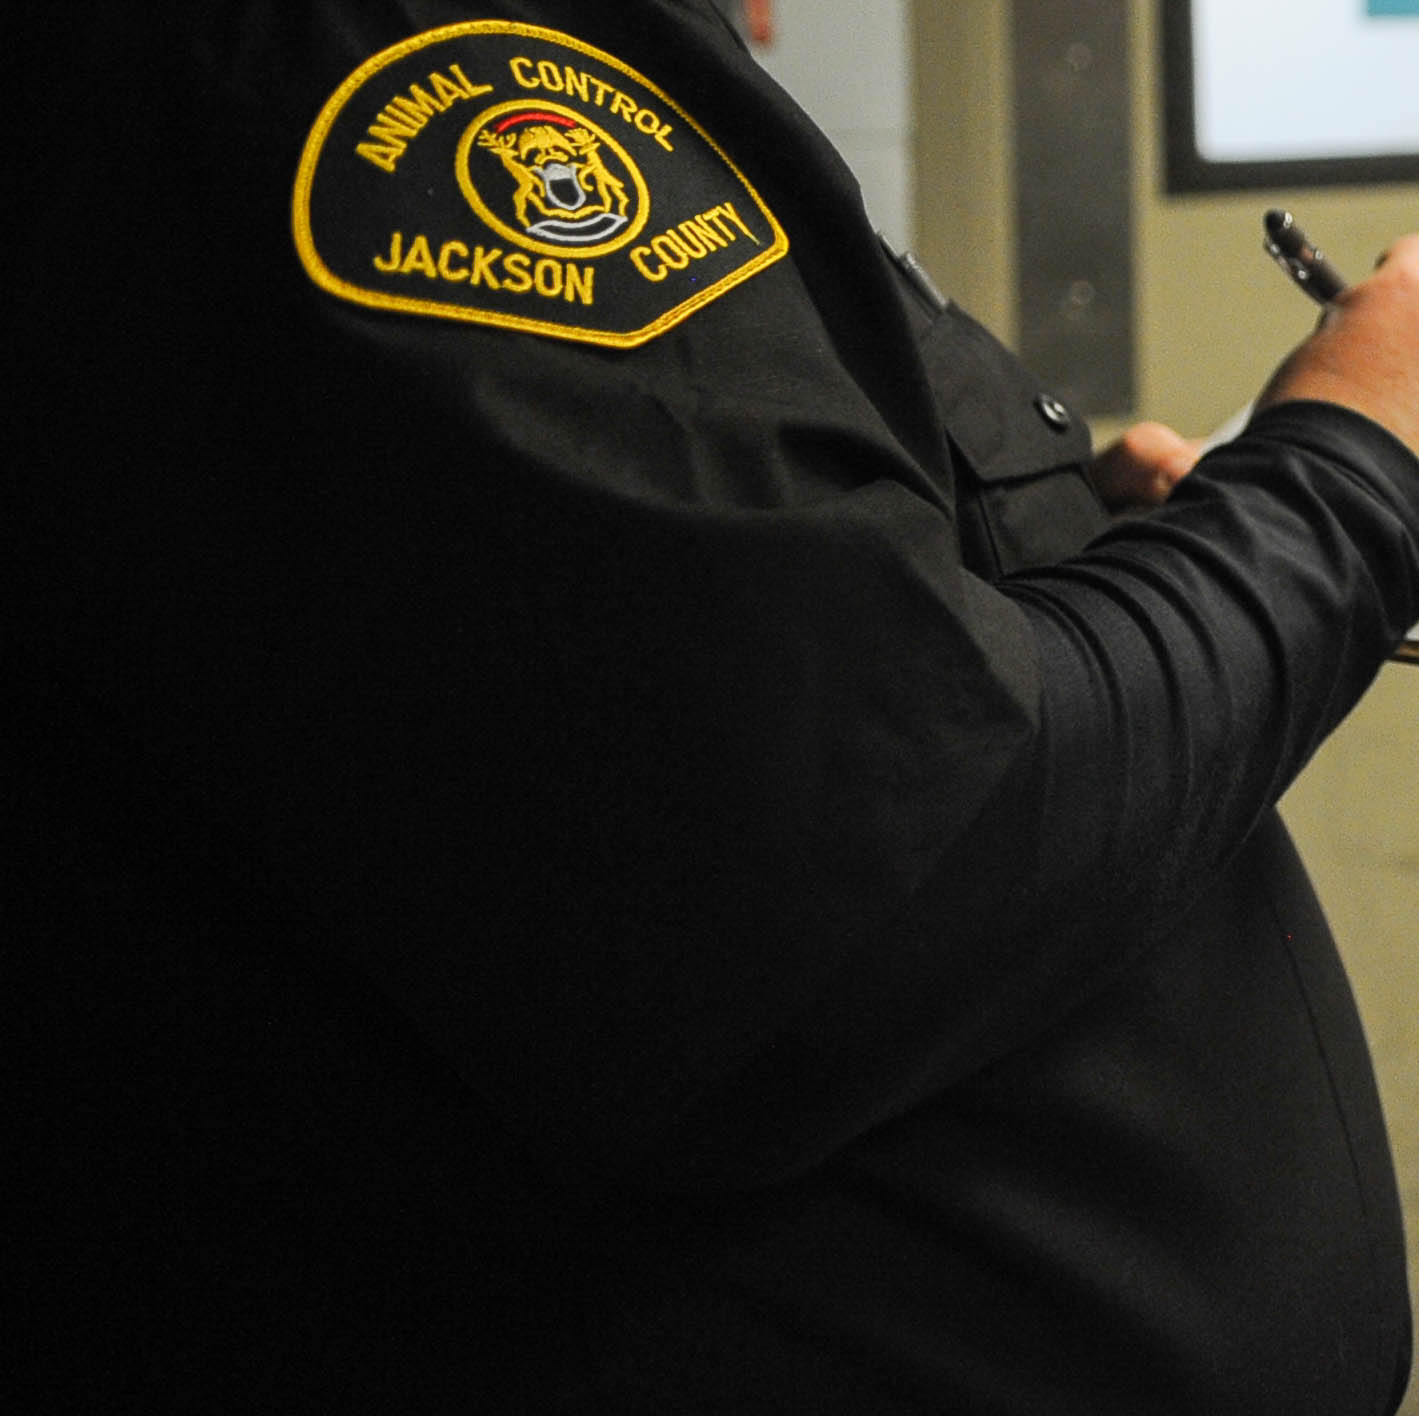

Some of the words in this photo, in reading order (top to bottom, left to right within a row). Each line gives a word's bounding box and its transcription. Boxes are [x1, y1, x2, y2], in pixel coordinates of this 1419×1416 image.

[356, 64, 493, 172] ANIMAL
[509, 56, 675, 152] CONTROL
[374, 232, 594, 304] JACKSON
[629, 202, 760, 282] COUNTY
